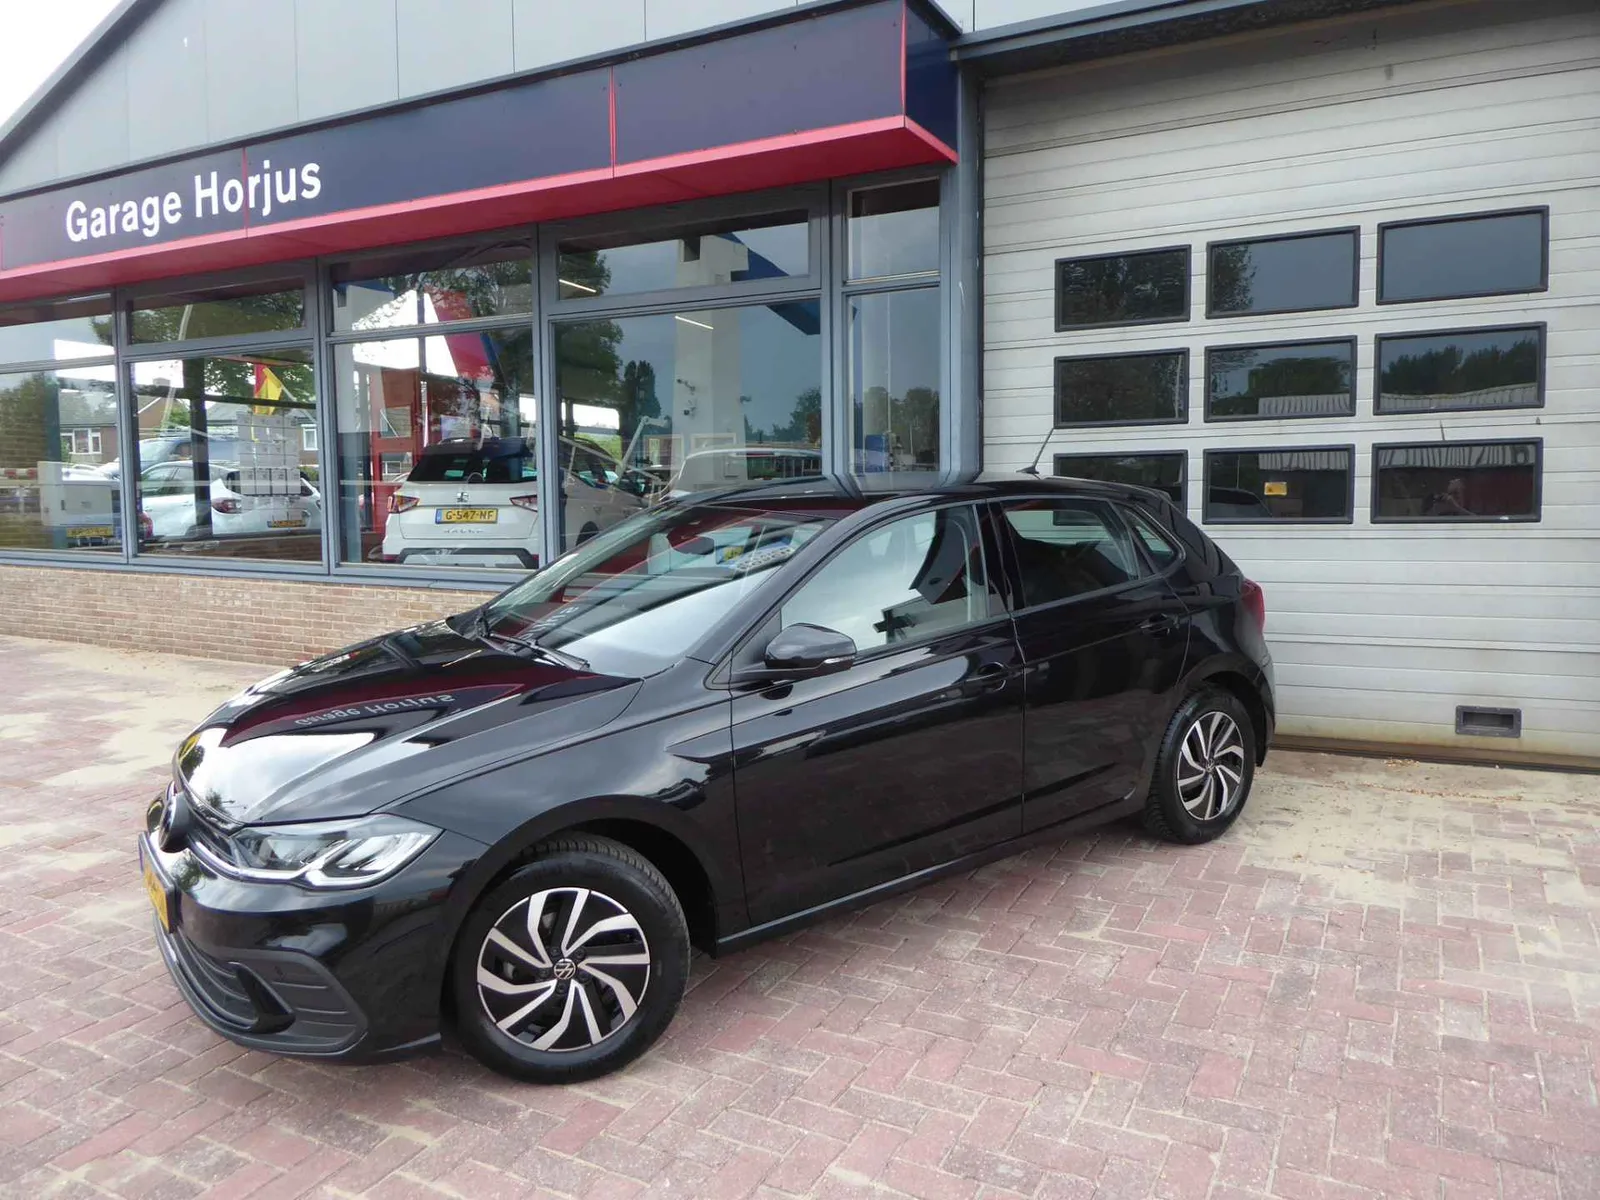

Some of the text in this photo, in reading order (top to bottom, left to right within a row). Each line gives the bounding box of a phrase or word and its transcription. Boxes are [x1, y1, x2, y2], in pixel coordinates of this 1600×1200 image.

[66, 160, 322, 241] Garage Horjus
[445, 510, 494, 520] G-547-NF
